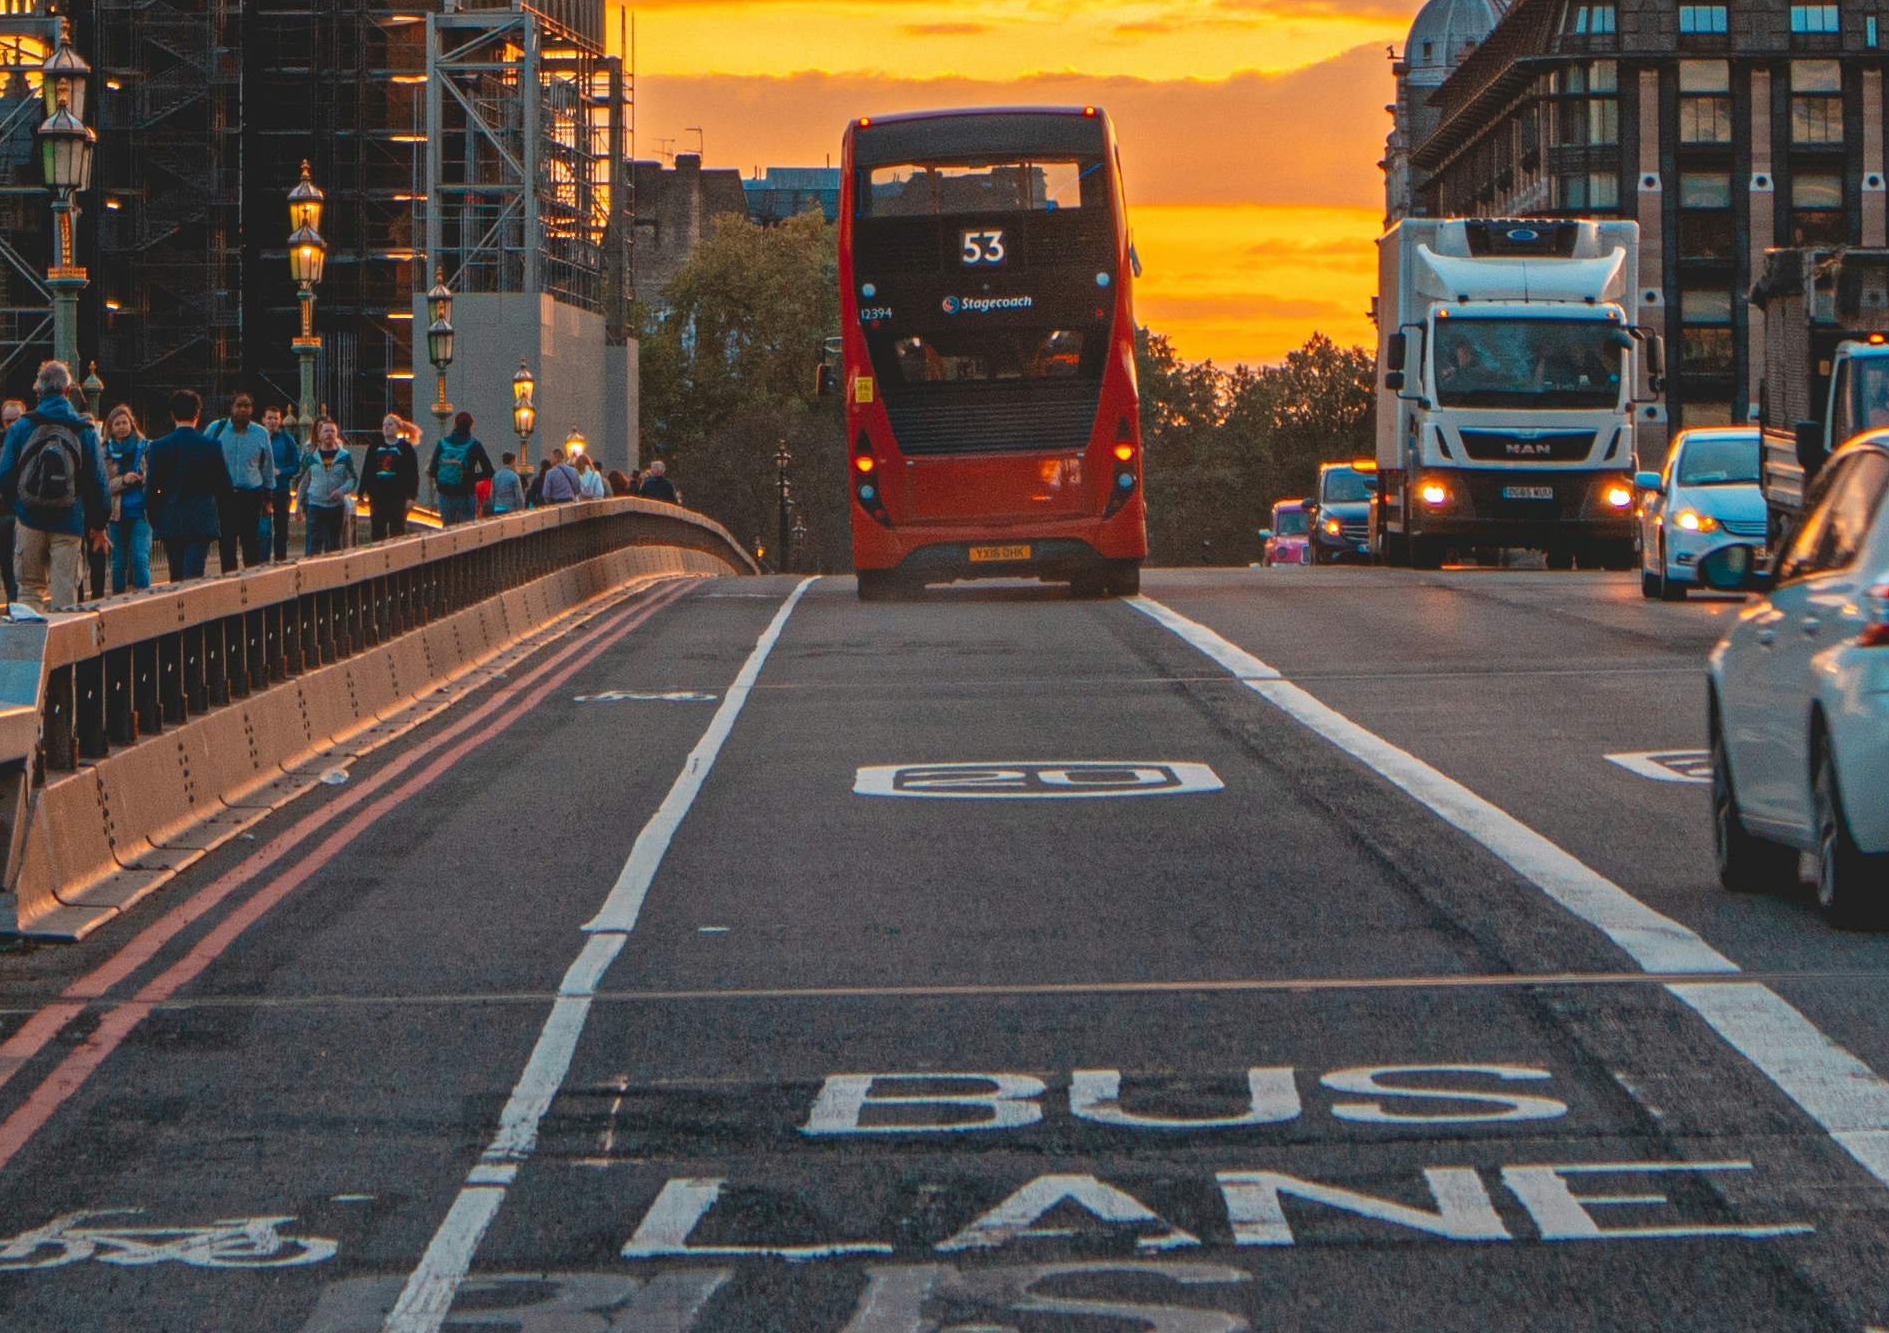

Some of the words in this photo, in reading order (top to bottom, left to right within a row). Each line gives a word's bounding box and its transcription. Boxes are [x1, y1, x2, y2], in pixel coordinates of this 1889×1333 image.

[963, 231, 1005, 264] 53
[961, 296, 1033, 313] Stagecoach
[861, 307, 893, 320] 12394
[1505, 443, 1551, 454] MAN
[902, 770, 1169, 787] 20
[803, 1063, 1570, 1134] BUS
[619, 1160, 1817, 1259] LANE
